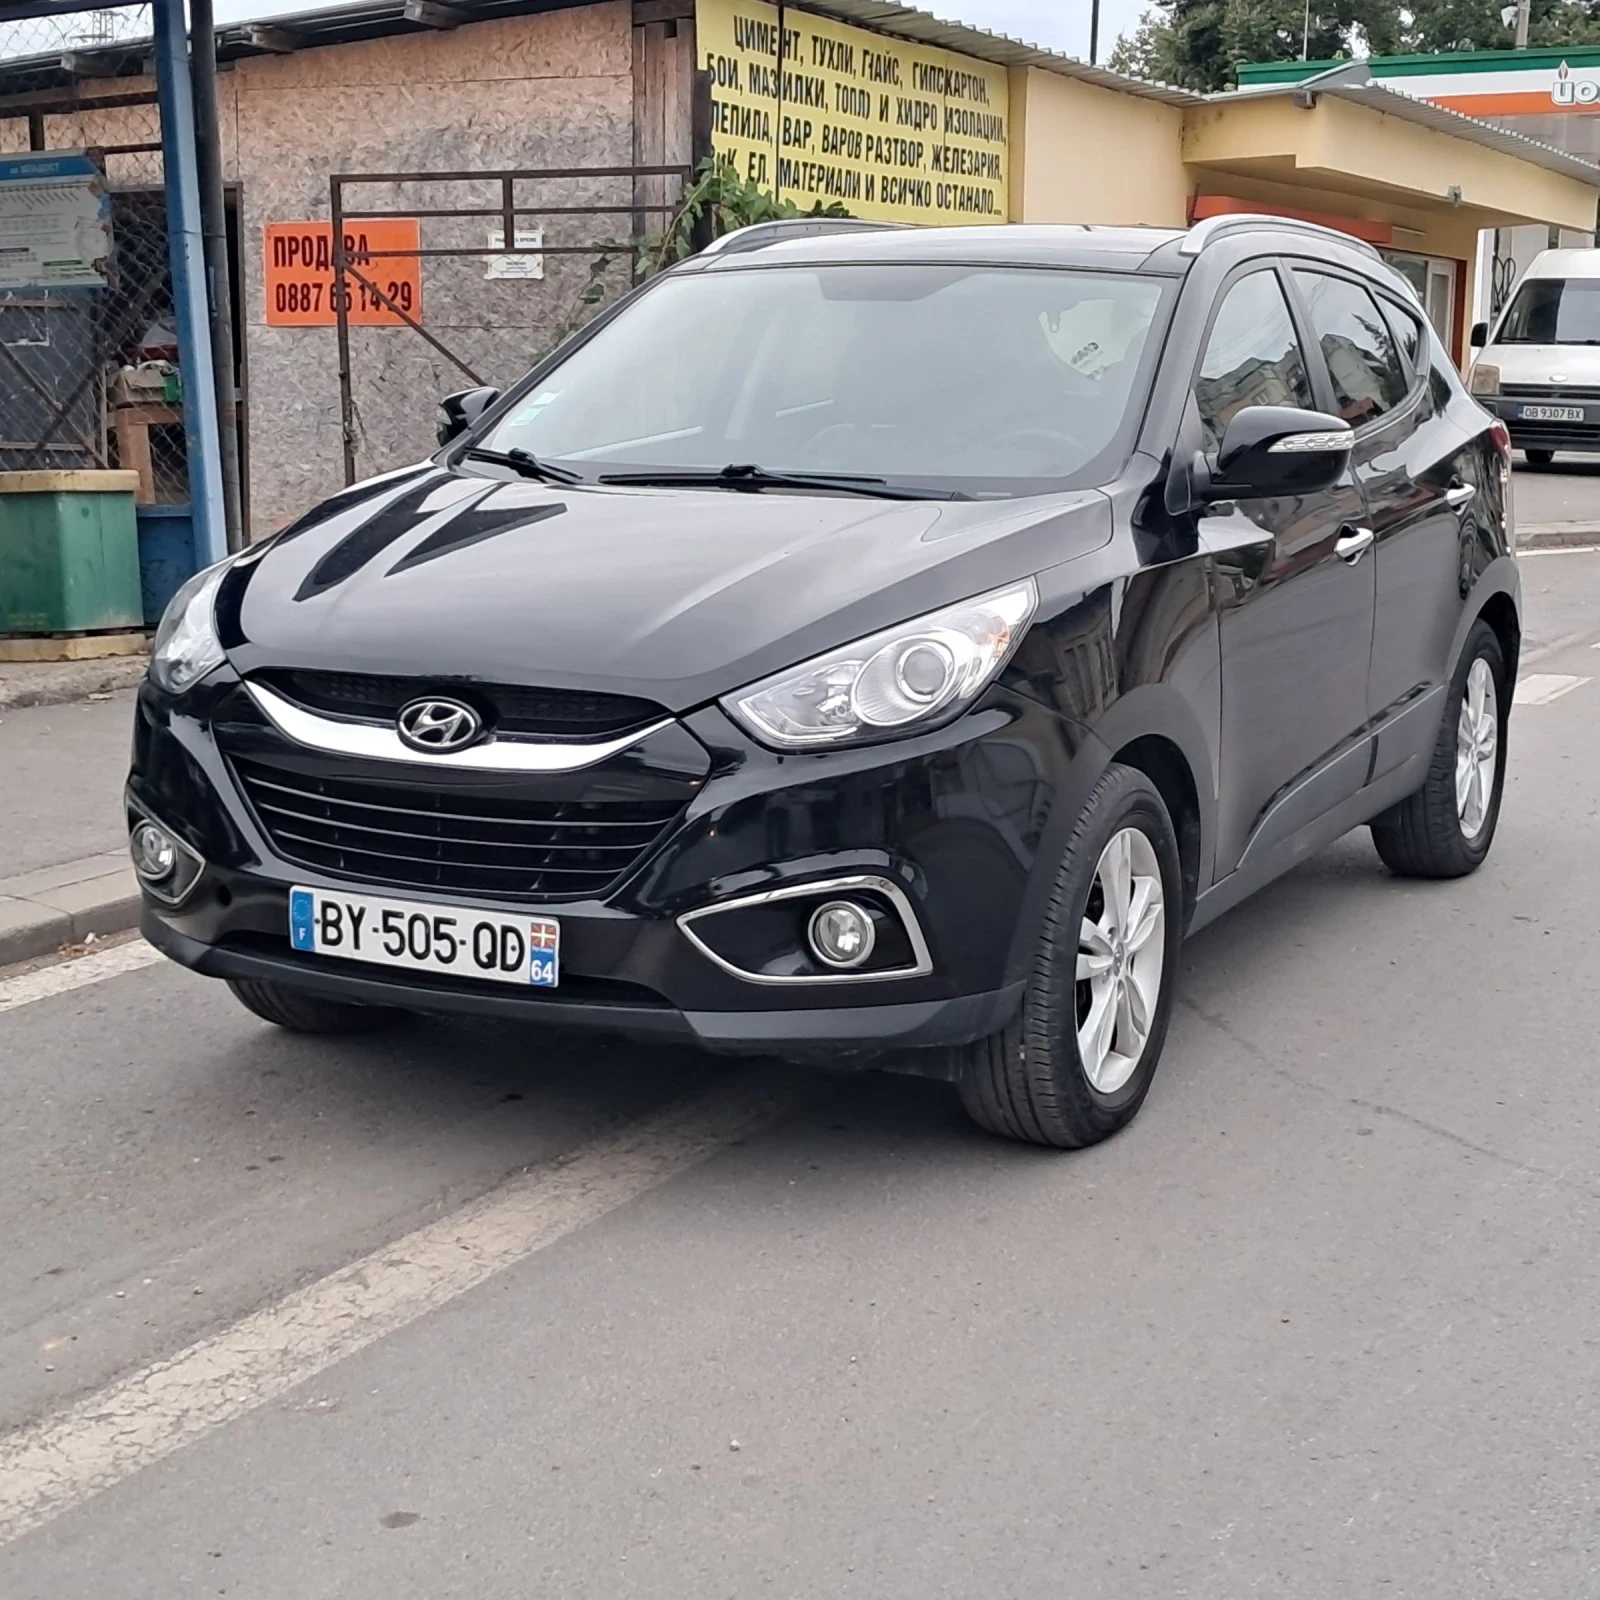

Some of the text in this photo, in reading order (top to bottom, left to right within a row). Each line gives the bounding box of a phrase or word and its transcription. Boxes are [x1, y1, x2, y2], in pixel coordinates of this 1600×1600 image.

[733, 15, 804, 67] ЦИМЕНТ,
[811, 34, 857, 80] ТУХЛИ,
[748, 62, 829, 114] МАЗИЛКИ,
[879, 93, 889, 124] И
[896, 96, 938, 132] ХИДРО
[782, 115, 815, 156] ВАР,
[821, 123, 863, 160] ВАРОВ
[748, 151, 770, 185] ЕЛ.
[779, 157, 861, 201] МАТЕРИАЛИ
[865, 173, 875, 202] И
[880, 175, 932, 210] ВСИЧКО
[273, 234, 370, 271] ПРОДВА
[275, 282, 324, 313] 0887
[387, 281, 413, 312] 29
[1540, 408, 1565, 419] 9307
[1567, 409, 1581, 419] BX
[299, 927, 306, 941] F
[531, 959, 554, 983] 64
